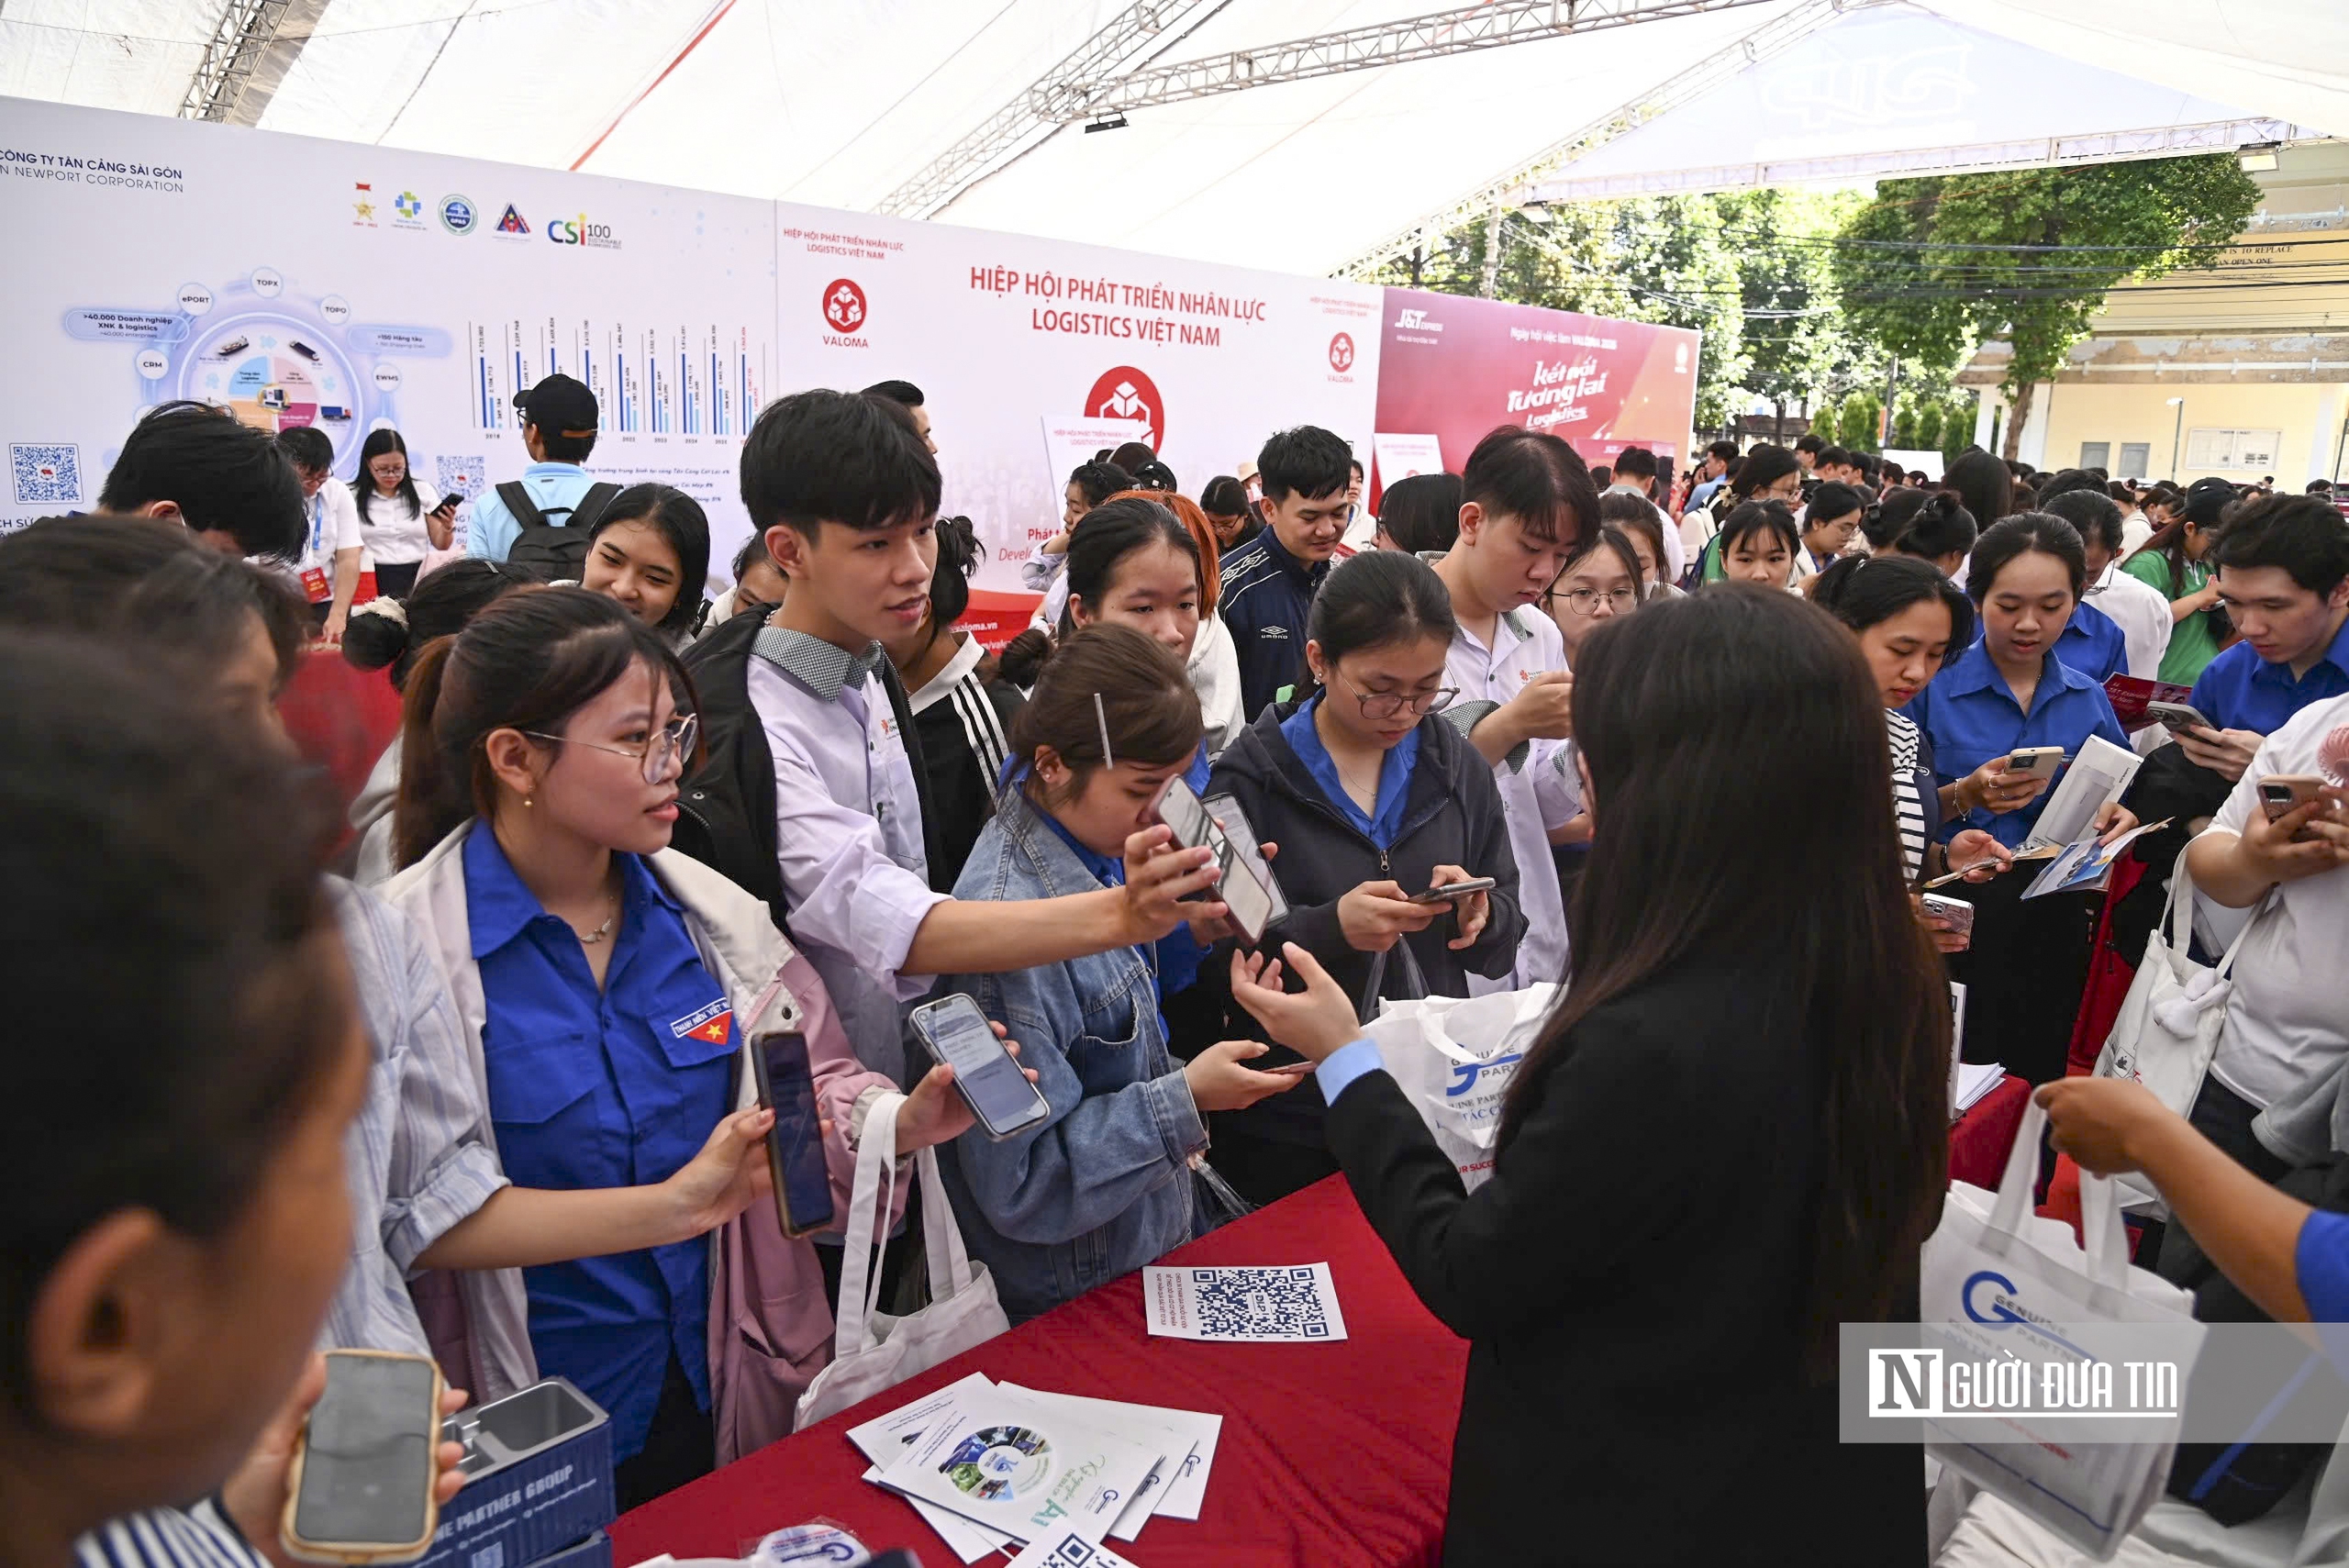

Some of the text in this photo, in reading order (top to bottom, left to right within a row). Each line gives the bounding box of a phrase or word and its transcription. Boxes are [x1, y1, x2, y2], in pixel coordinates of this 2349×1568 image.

[40, 155, 55, 166] TY
[58, 156, 83, 169] TÂN
[87, 158, 127, 173] CẢNG
[129, 163, 150, 176] SÀI
[152, 166, 183, 179] GÒN
[16, 166, 82, 183] NEWPORT
[86, 173, 184, 193] CORPORATION
[587, 224, 611, 239] 100
[784, 228, 904, 251] HIỆP HỘI PHÁT TRIỂN NHÂN LỰC
[807, 244, 885, 260] LOGISTICS VIỆT NAM
[2255, 245, 2293, 253] REPLACE
[257, 279, 279, 287] TOPX
[183, 295, 209, 304] ePORT
[970, 264, 1266, 326] HIỆP HỘI PHÁT TRIỂN NHÂN LỰC
[117, 315, 144, 323] Doanh
[145, 316, 173, 325] nghiệp
[126, 323, 158, 332] logistics
[1032, 308, 1220, 347] LOGISTICS VIỆT NAM
[1395, 308, 1428, 330] J&T
[822, 335, 869, 348] VALOMA
[1510, 327, 1530, 342] Ngày
[1531, 328, 1542, 342] hội
[1543, 330, 1557, 344] việc
[143, 361, 162, 369] CRM
[1508, 371, 1609, 412] Tương lai
[674, 1004, 722, 1033] THANH NIÊN VIỆT
[457, 1490, 522, 1531] PARTNER
[525, 1464, 573, 1499] GROUP
